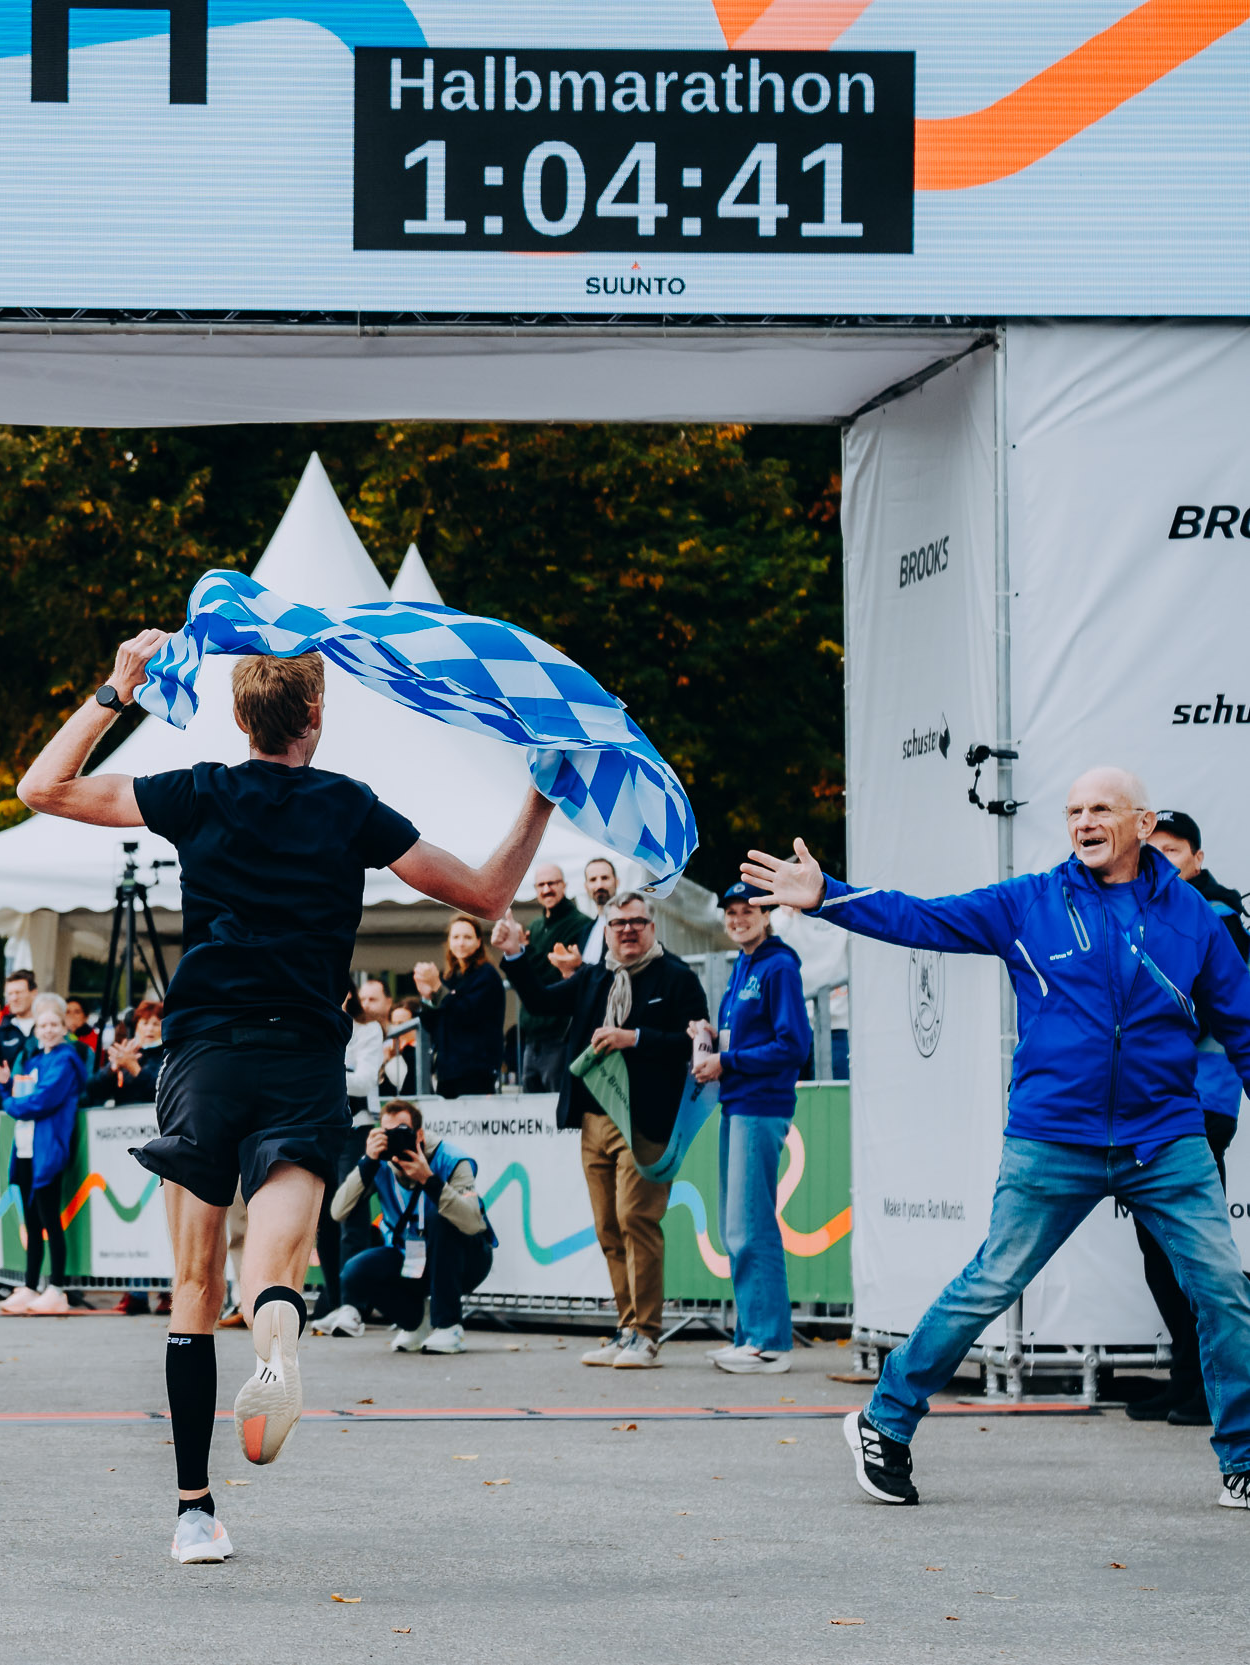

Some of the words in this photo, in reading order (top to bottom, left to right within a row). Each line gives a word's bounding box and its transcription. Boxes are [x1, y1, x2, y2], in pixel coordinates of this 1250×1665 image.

[388, 56, 876, 115] Halbmarathon
[402, 139, 865, 239] 1:04:41
[585, 276, 686, 297] SUUNTO
[1168, 504, 1250, 539] BR
[899, 535, 949, 589] BROOKS
[902, 727, 939, 761] schuster
[883, 1197, 901, 1217] Make
[928, 1199, 940, 1219] Run
